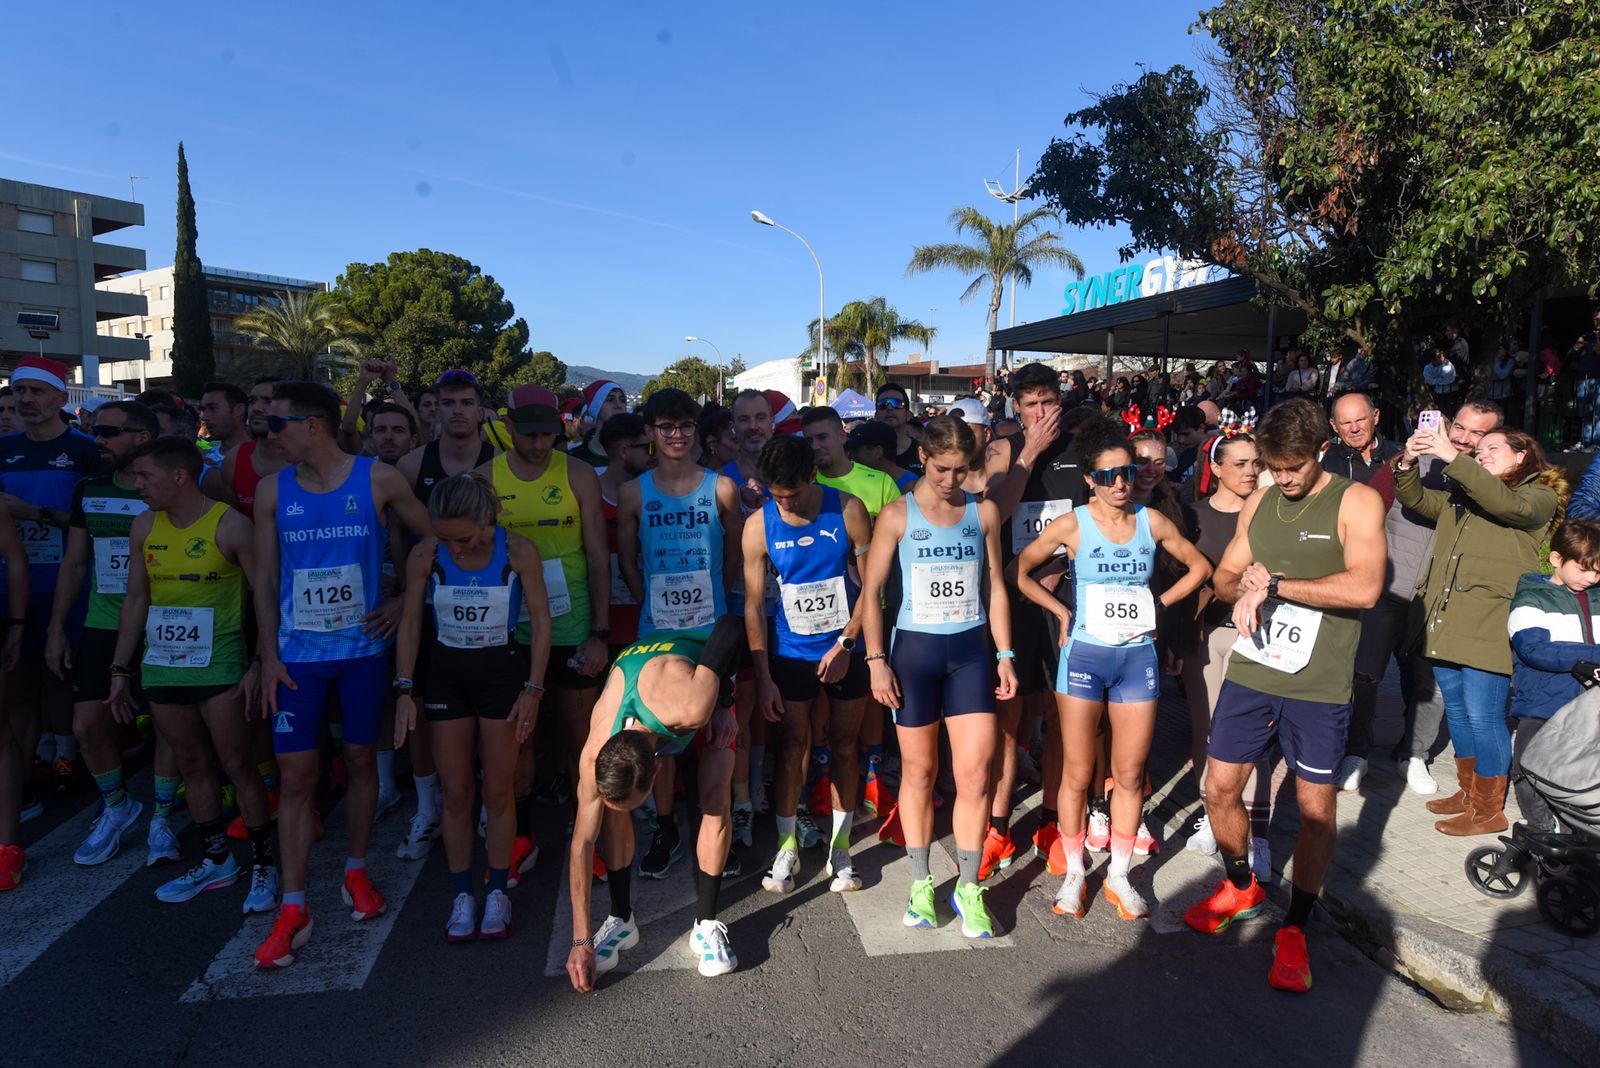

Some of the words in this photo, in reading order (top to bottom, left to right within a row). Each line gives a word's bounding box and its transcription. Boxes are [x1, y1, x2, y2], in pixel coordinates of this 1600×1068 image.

[647, 505, 710, 530] nerja
[282, 524, 370, 543] TROTASIERRA
[659, 531, 702, 541] ATLETISMO
[917, 542, 976, 560] nerja
[1097, 559, 1147, 575] nerja
[303, 584, 352, 605] 1126
[661, 588, 702, 606] 1392
[930, 581, 964, 598] 885
[794, 593, 836, 613] 1237
[1104, 602, 1138, 619] 858
[454, 605, 490, 622] 667
[156, 624, 200, 642] 1524
[1069, 671, 1092, 680] nerja
